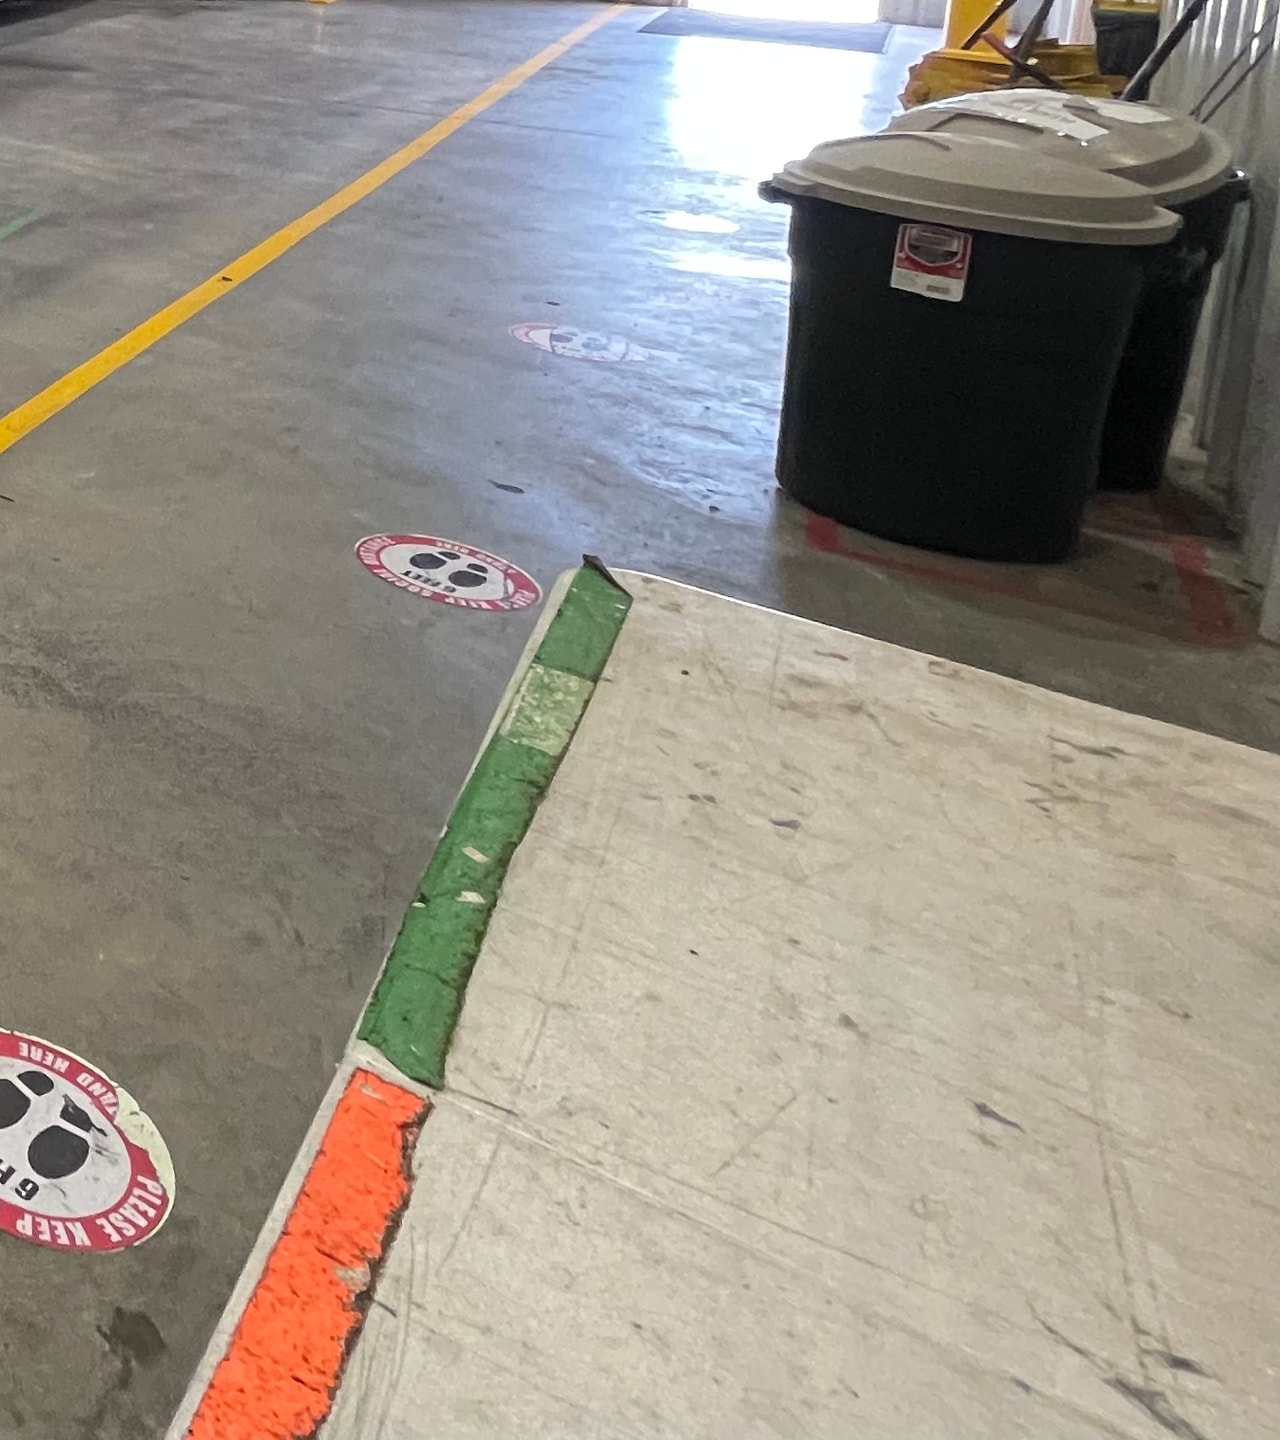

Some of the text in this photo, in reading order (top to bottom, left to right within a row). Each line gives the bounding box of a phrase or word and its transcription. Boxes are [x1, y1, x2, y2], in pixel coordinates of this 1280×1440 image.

[18, 1041, 70, 1073] HERE
[14, 1178, 40, 1201] 6
[95, 1174, 163, 1243] PLEASE
[15, 1213, 92, 1246] KEEP
